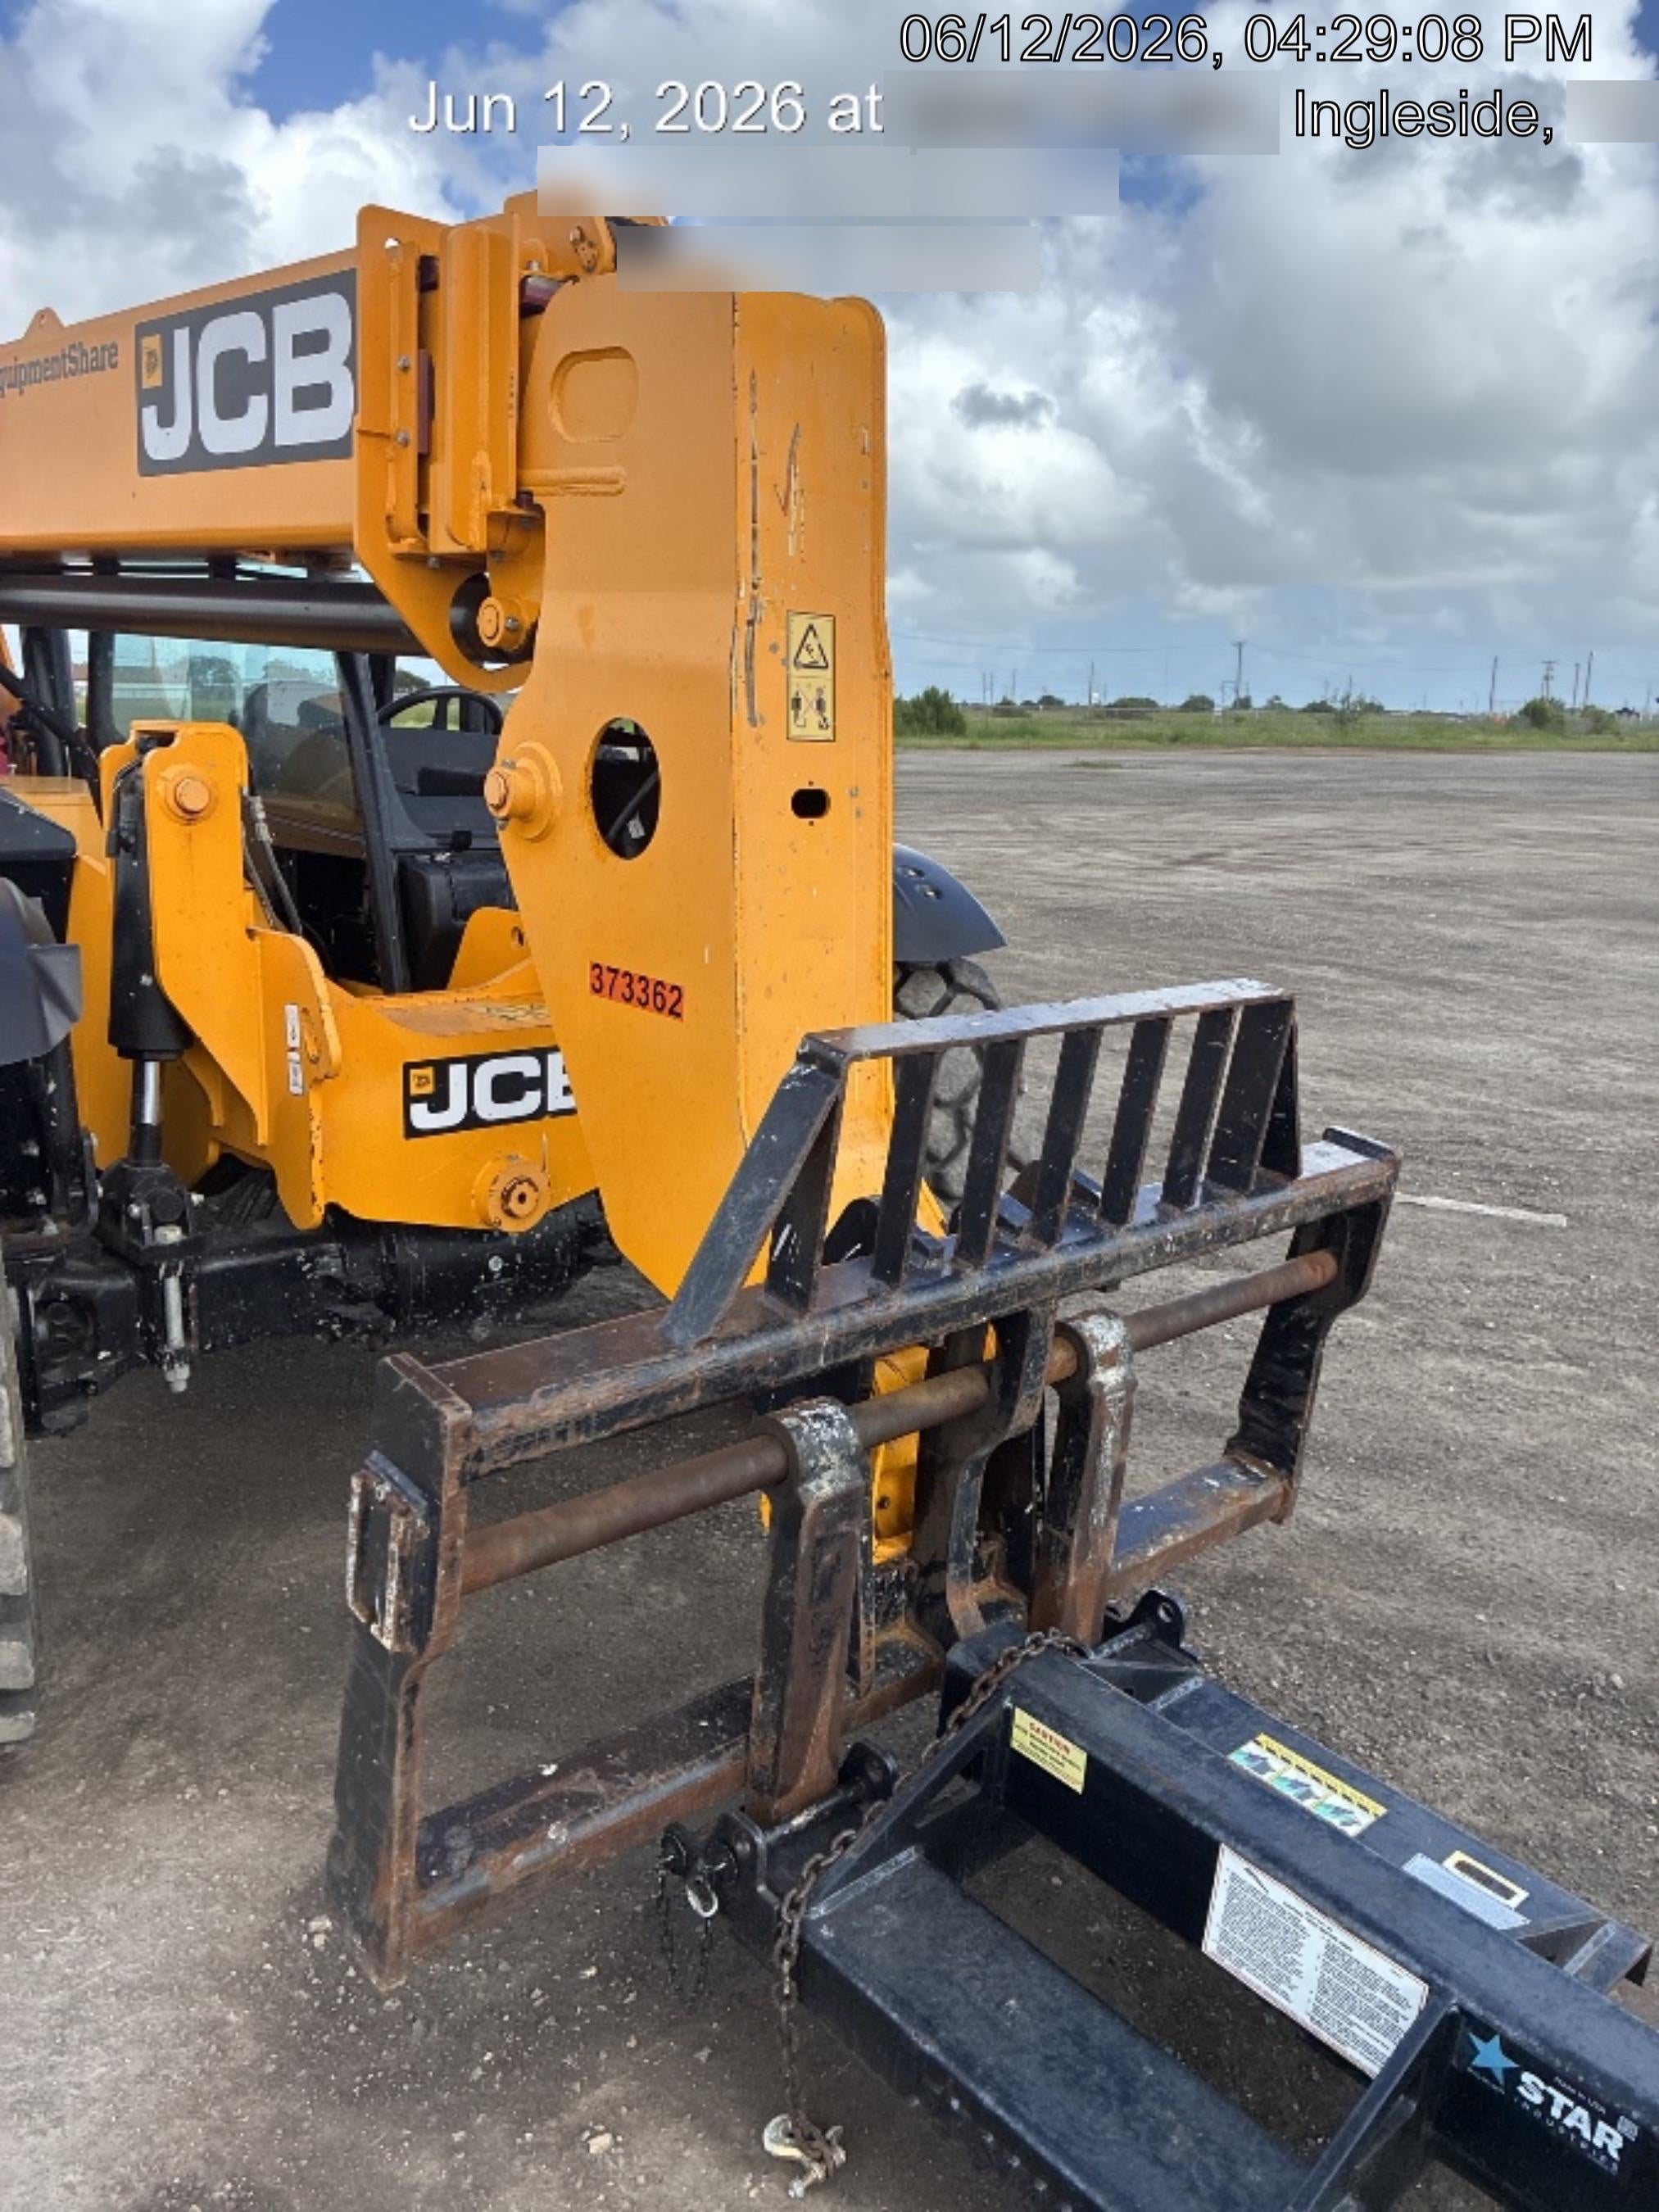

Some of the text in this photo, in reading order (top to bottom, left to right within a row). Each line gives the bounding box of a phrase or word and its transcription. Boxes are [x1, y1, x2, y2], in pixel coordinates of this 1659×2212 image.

[142, 292, 354, 460] JCB
[591, 963, 683, 1019] 373362
[1516, 2070, 1625, 2163] STAR
